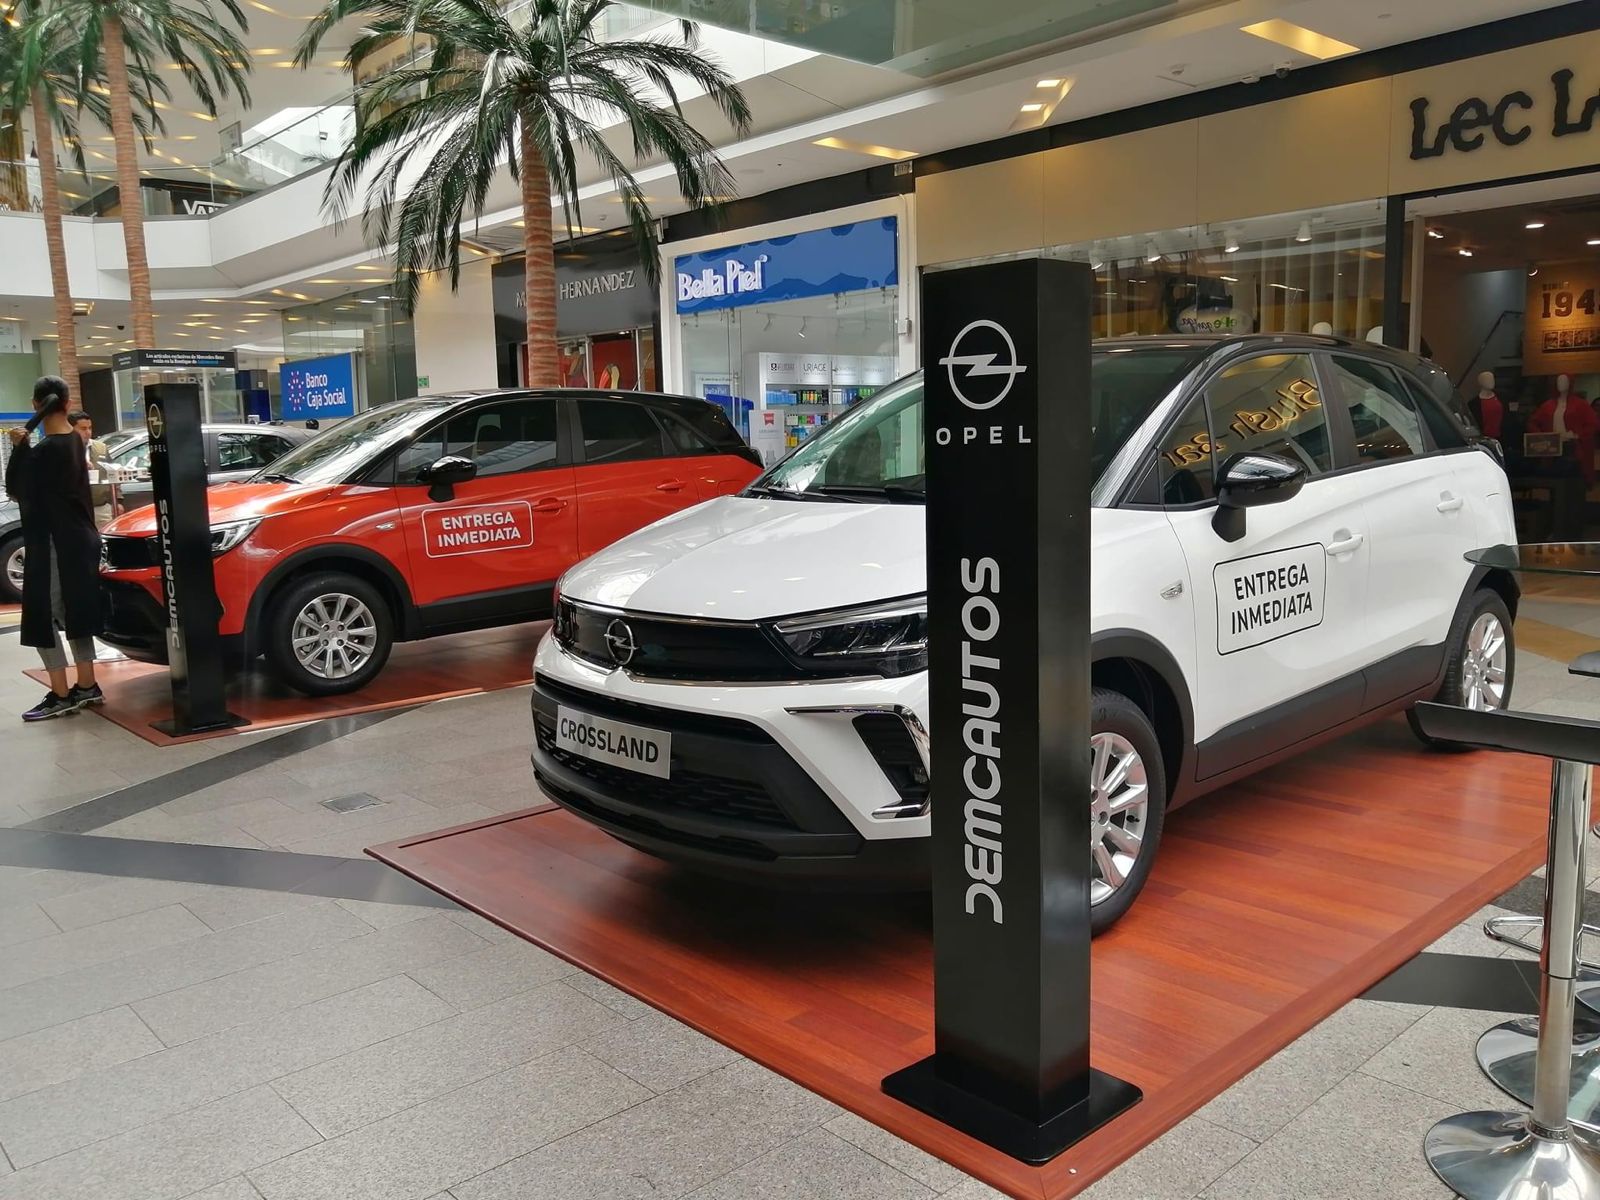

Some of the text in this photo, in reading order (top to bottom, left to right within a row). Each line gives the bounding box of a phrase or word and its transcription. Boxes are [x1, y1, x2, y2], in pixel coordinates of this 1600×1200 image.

[1409, 68, 1600, 160] Lec L
[559, 270, 636, 300] HERNANDEZ
[678, 259, 762, 301] Bella Piel
[1542, 288, 1600, 318] 194
[305, 372, 328, 388] Banco
[306, 387, 347, 410] Caja Social
[935, 425, 1032, 446] OPEL
[441, 511, 515, 530] ENTREGA
[437, 526, 521, 547] INMEDIATA
[1233, 563, 1309, 601] ENTREGA
[1231, 591, 1313, 635] INMEDIATA
[560, 718, 659, 763] CROSSLAND
[961, 557, 1003, 924] DEMCAUTOS
